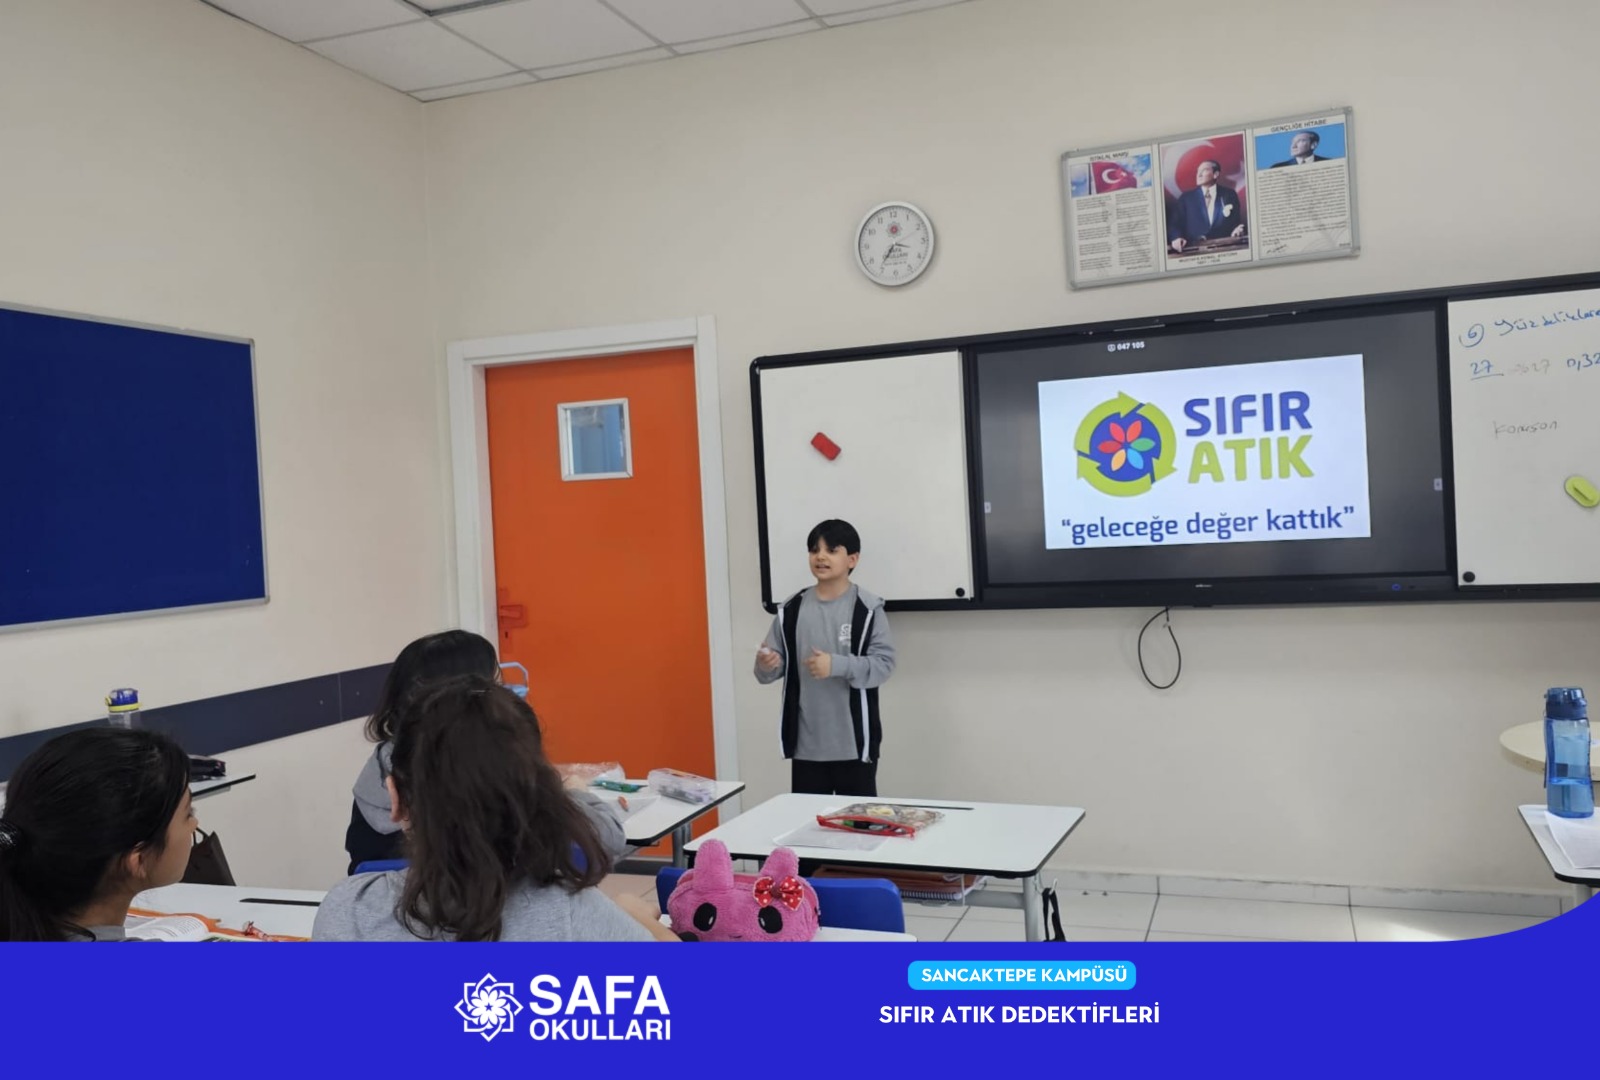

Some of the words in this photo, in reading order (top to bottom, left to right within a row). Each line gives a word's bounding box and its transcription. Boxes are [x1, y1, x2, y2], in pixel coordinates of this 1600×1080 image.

[1304, 118, 1327, 128] HİTABE
[868, 228, 876, 236] 10
[1117, 342, 1131, 351] 047
[1131, 341, 1145, 350] 105
[1470, 359, 1493, 375] 27
[1183, 390, 1313, 437] SIFIR
[1187, 434, 1315, 484] ATIK
[1061, 514, 1178, 545] “geleceğe
[1186, 512, 1258, 540] değer
